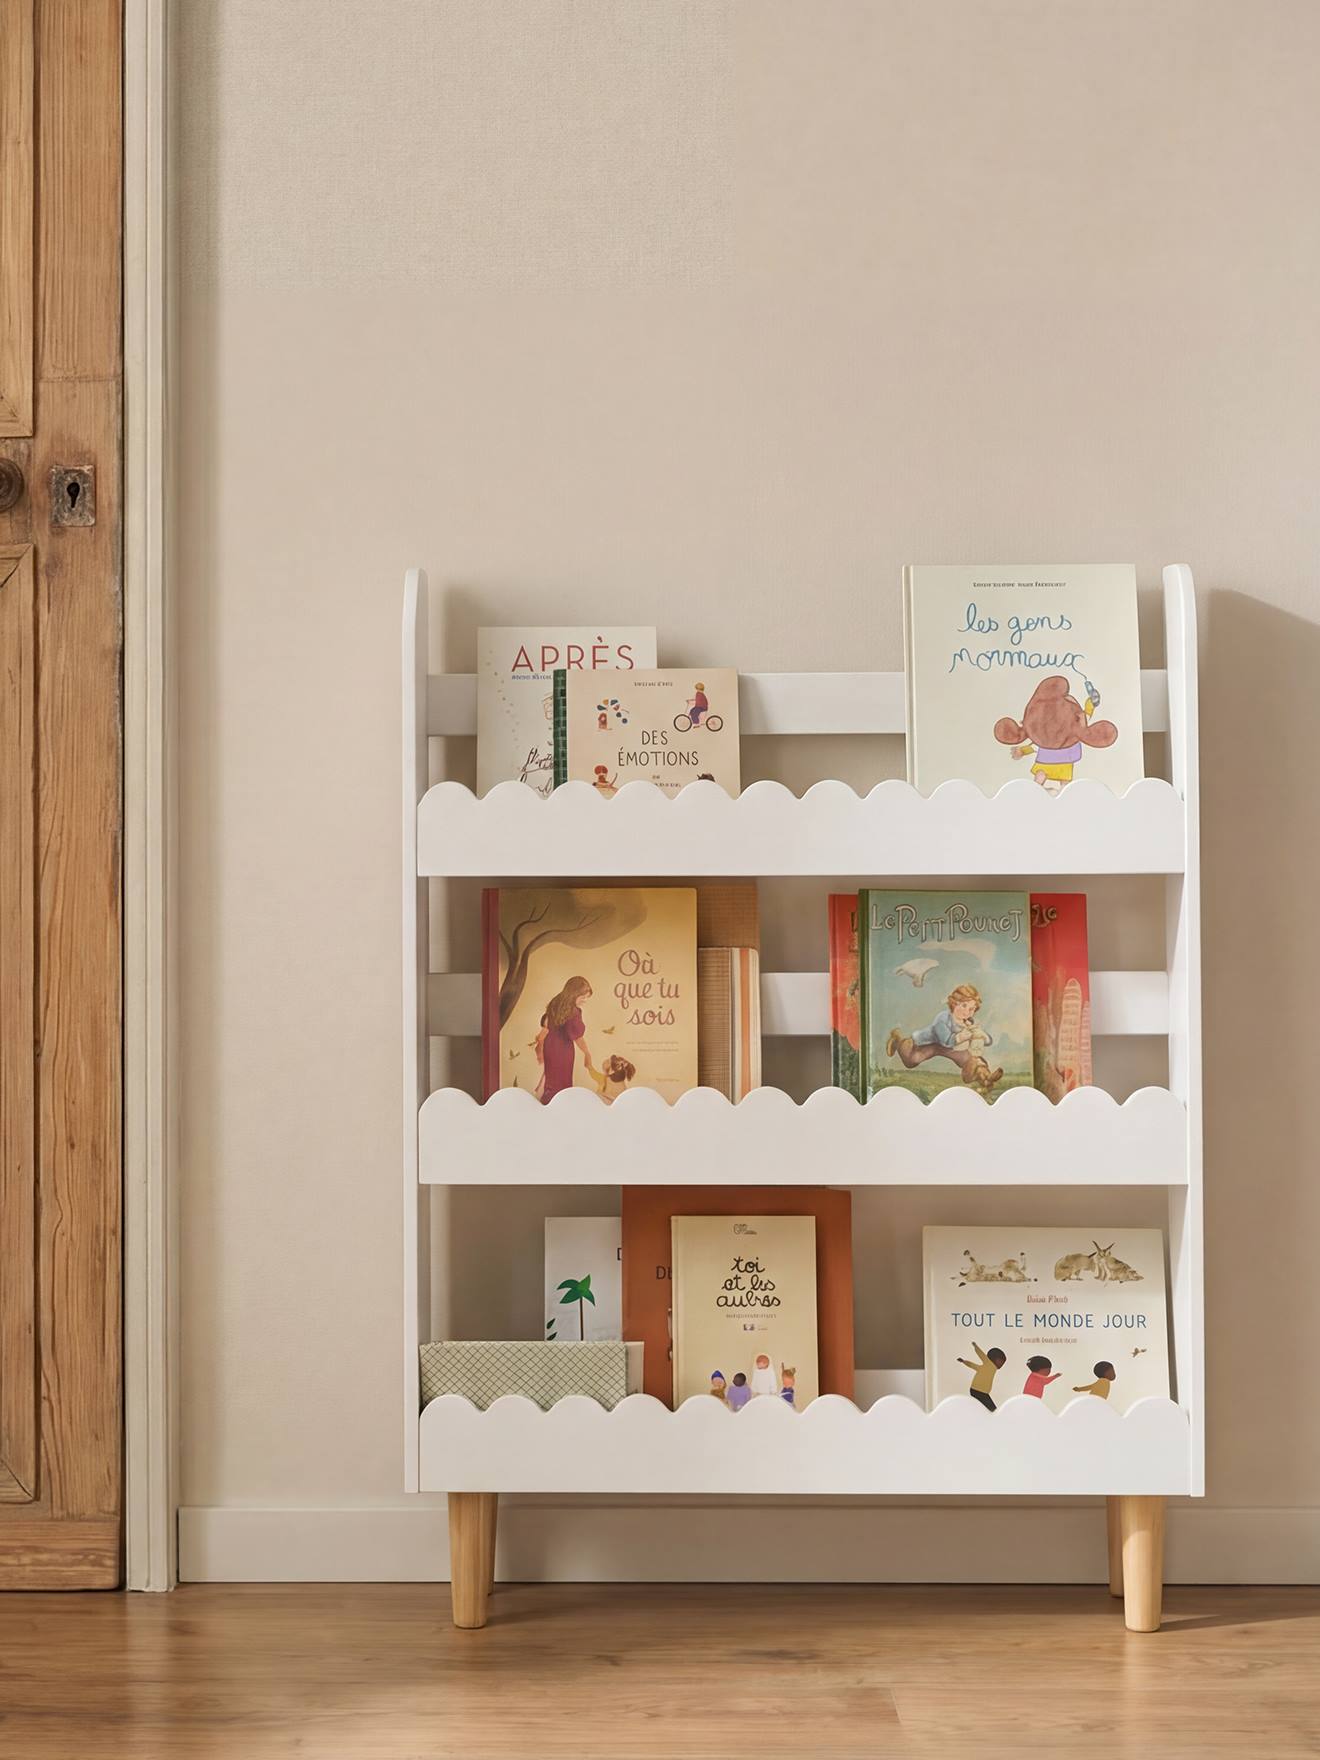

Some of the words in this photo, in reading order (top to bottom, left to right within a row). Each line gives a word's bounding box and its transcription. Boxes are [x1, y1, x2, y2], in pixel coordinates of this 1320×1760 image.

[957, 602, 999, 634] les
[511, 635, 634, 672] APRÈS
[641, 730, 668, 746] DES
[618, 746, 699, 766] ÉMOTIONS
[614, 982, 653, 1009] que
[657, 978, 680, 998] tu
[627, 1005, 675, 1025] sois
[731, 1256, 765, 1273] toi
[951, 1312, 995, 1328] TOUT
[1004, 1313, 1024, 1328] LE
[1034, 1313, 1094, 1328] MONDE
[1103, 1314, 1147, 1329] JOUR
